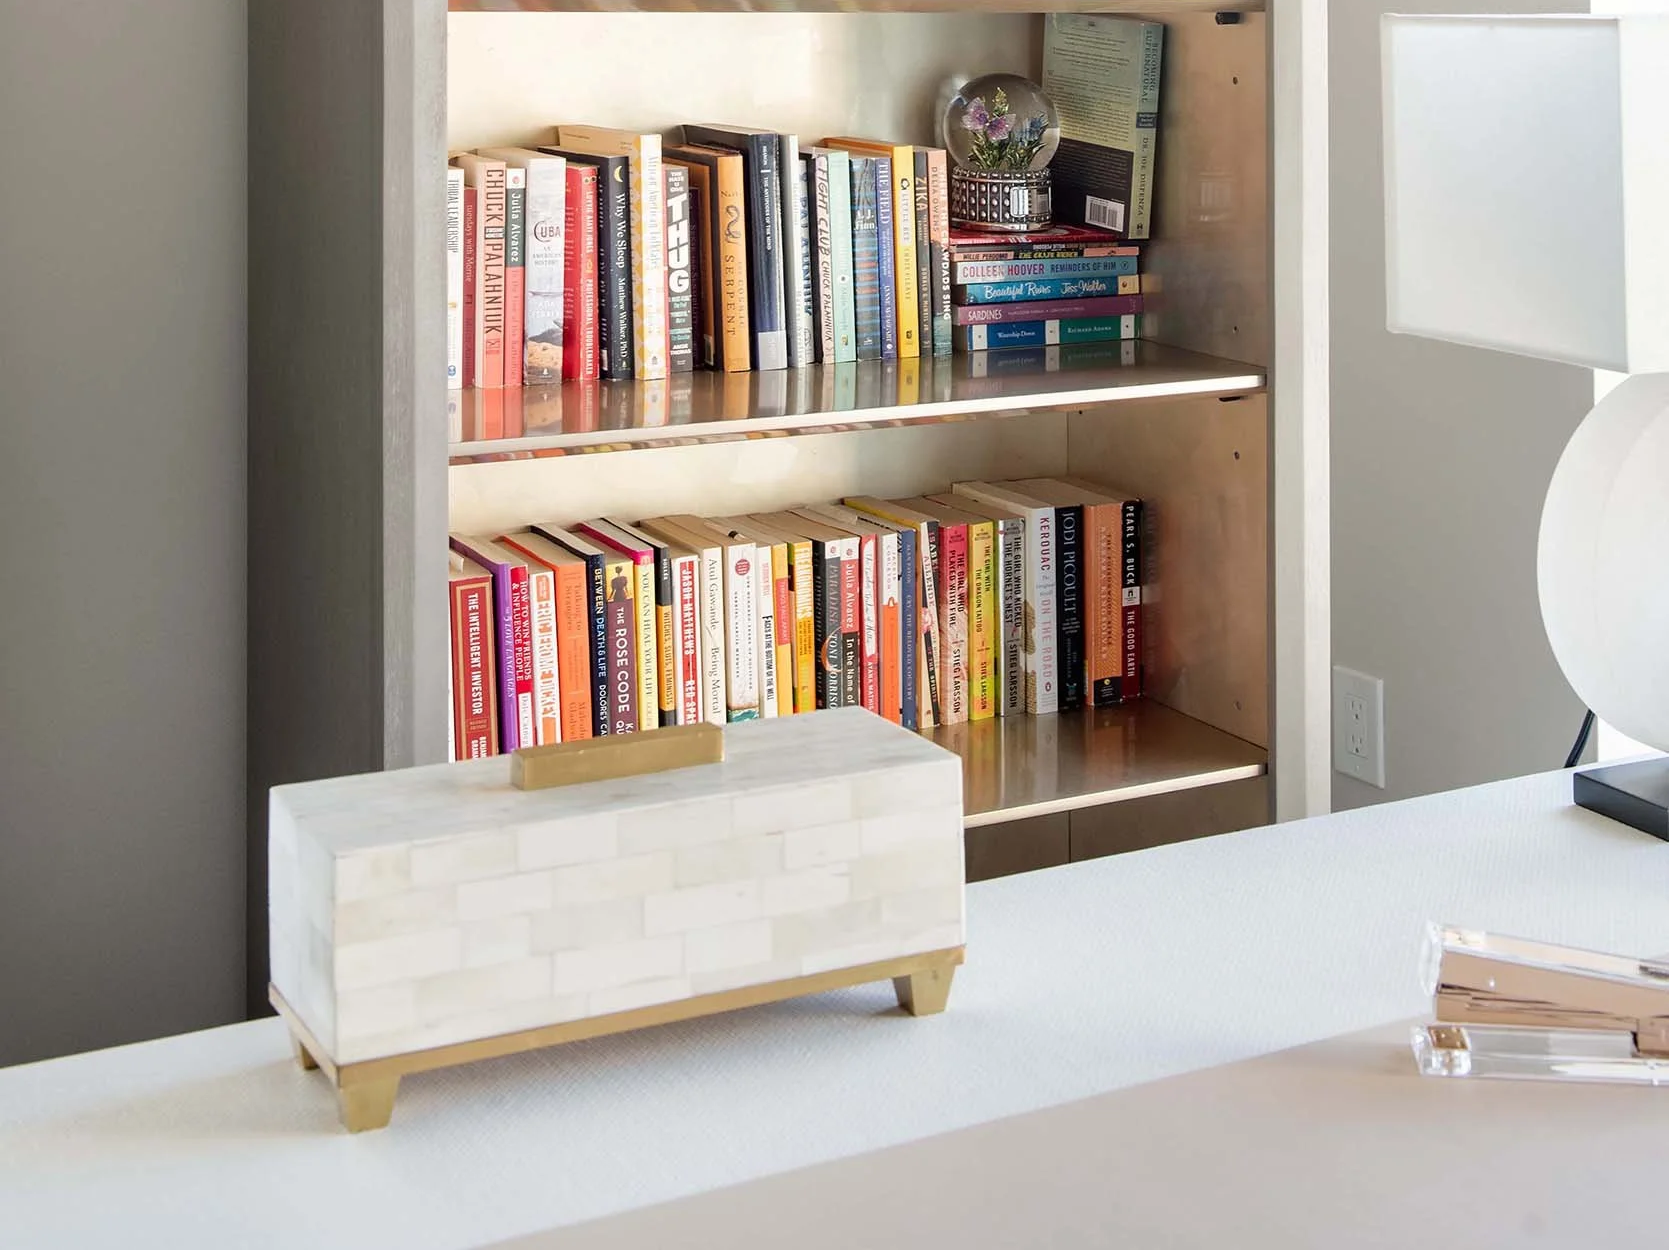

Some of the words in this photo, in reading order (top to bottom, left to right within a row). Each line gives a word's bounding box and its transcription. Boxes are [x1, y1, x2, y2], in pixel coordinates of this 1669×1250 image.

[916, 176, 929, 211] ZIKA
[931, 166, 939, 195] DELIA
[486, 169, 505, 222] CHUCK
[512, 192, 522, 221] Julia
[614, 194, 626, 218] Why
[879, 188, 891, 224] FIELD
[615, 219, 627, 239] We
[932, 199, 940, 232] OWENS
[512, 224, 522, 263] Alvarez
[534, 220, 562, 242] CUBA
[819, 217, 830, 256] CLUB
[615, 240, 628, 270] Sleep
[1051, 263, 1091, 273] REMINDERS
[822, 261, 832, 291] CHUCK
[963, 264, 1006, 278] COLLEEN
[1008, 264, 1045, 275] HOOVER
[484, 243, 504, 334] PALAHNIUK
[724, 254, 736, 337] SERPENT
[984, 284, 1024, 299] Beautiful
[1025, 283, 1052, 297] Ruins
[943, 295, 952, 320] SING
[968, 309, 1003, 321] SARDINES
[1062, 511, 1077, 546] JODI
[1125, 505, 1135, 539] PEARL
[1040, 516, 1051, 572] KEROUAC
[956, 552, 965, 570] THE
[1126, 558, 1136, 586] BUCK
[846, 563, 854, 590] Julia
[957, 572, 965, 590] GIRL
[1014, 574, 1023, 595] WHO
[1063, 551, 1077, 614] PICOULT
[468, 593, 480, 610] THE
[520, 581, 529, 602] HOW
[594, 569, 604, 615] BETWEEN
[949, 583, 957, 607] WITH
[957, 591, 966, 613] WHO
[513, 593, 524, 646] INFLUENCE
[521, 605, 530, 618] TO
[616, 607, 625, 625] THE
[846, 592, 855, 631] Alvarez
[1004, 603, 1013, 624] NEST
[1126, 611, 1136, 625] THE
[469, 613, 482, 669] INTELLIGENT
[522, 619, 531, 640] WIN
[597, 618, 607, 649] DEATH
[846, 638, 855, 649] In
[1041, 621, 1053, 643] THE
[1126, 628, 1136, 650] GOOD
[523, 641, 533, 681] FRIENDS
[615, 628, 630, 667] ROSE
[847, 650, 855, 667] the
[952, 648, 961, 674] STIEG
[515, 648, 525, 681] PEOPLE
[598, 658, 608, 678] LIFE
[1042, 647, 1053, 678] ROAD
[1126, 653, 1136, 677] EARTH
[472, 671, 485, 715] INVESTOR
[617, 671, 631, 713] CODE
[830, 662, 840, 710] MORRISO
[847, 668, 856, 693] Name
[953, 675, 962, 714] LARSSON
[1009, 671, 1018, 708] LARSSON
[599, 684, 609, 721] DOLORES
[711, 679, 721, 715] Mortal
